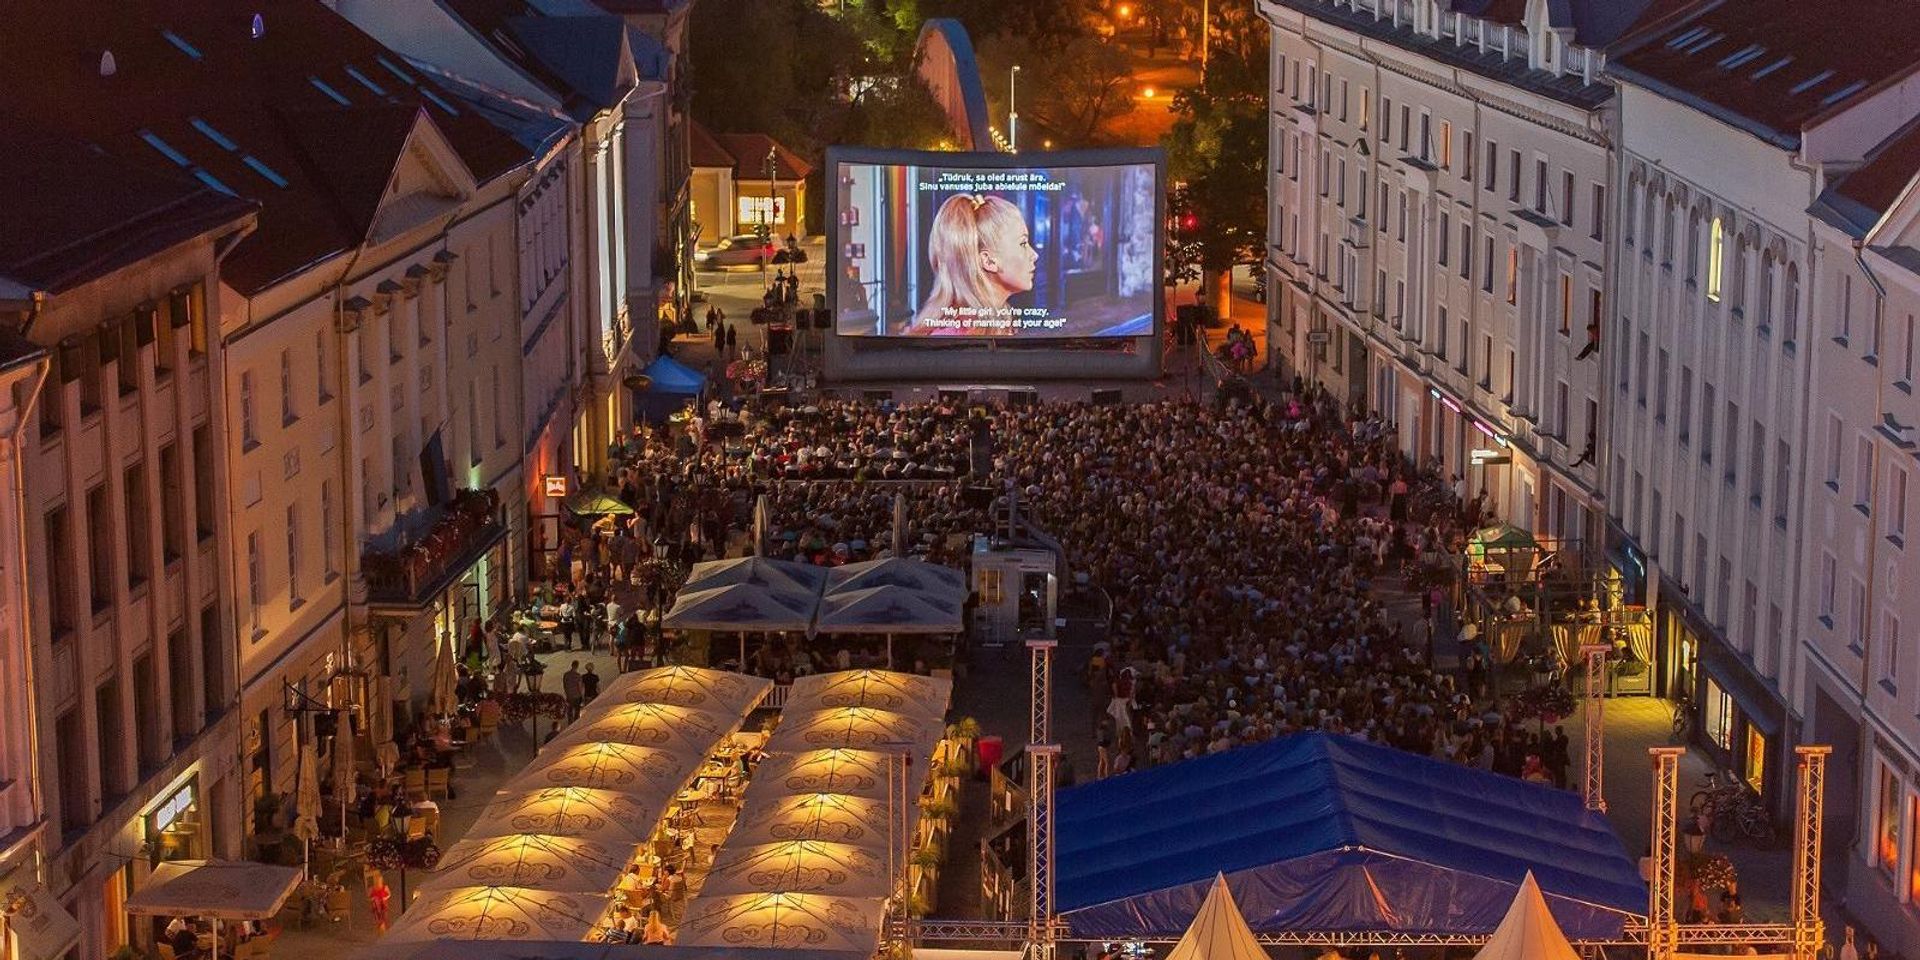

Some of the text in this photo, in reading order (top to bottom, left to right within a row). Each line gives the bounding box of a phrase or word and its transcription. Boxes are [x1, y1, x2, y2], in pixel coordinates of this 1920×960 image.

[987, 173, 1005, 181] oled
[974, 183, 993, 191] juba
[959, 307, 976, 315] little
[1024, 308, 1049, 317] crazy.
[925, 318, 960, 328] Thinking
[962, 319, 972, 327] of
[973, 319, 1011, 328] marriage
[1013, 319, 1021, 327] at
[1023, 320, 1042, 328] your
